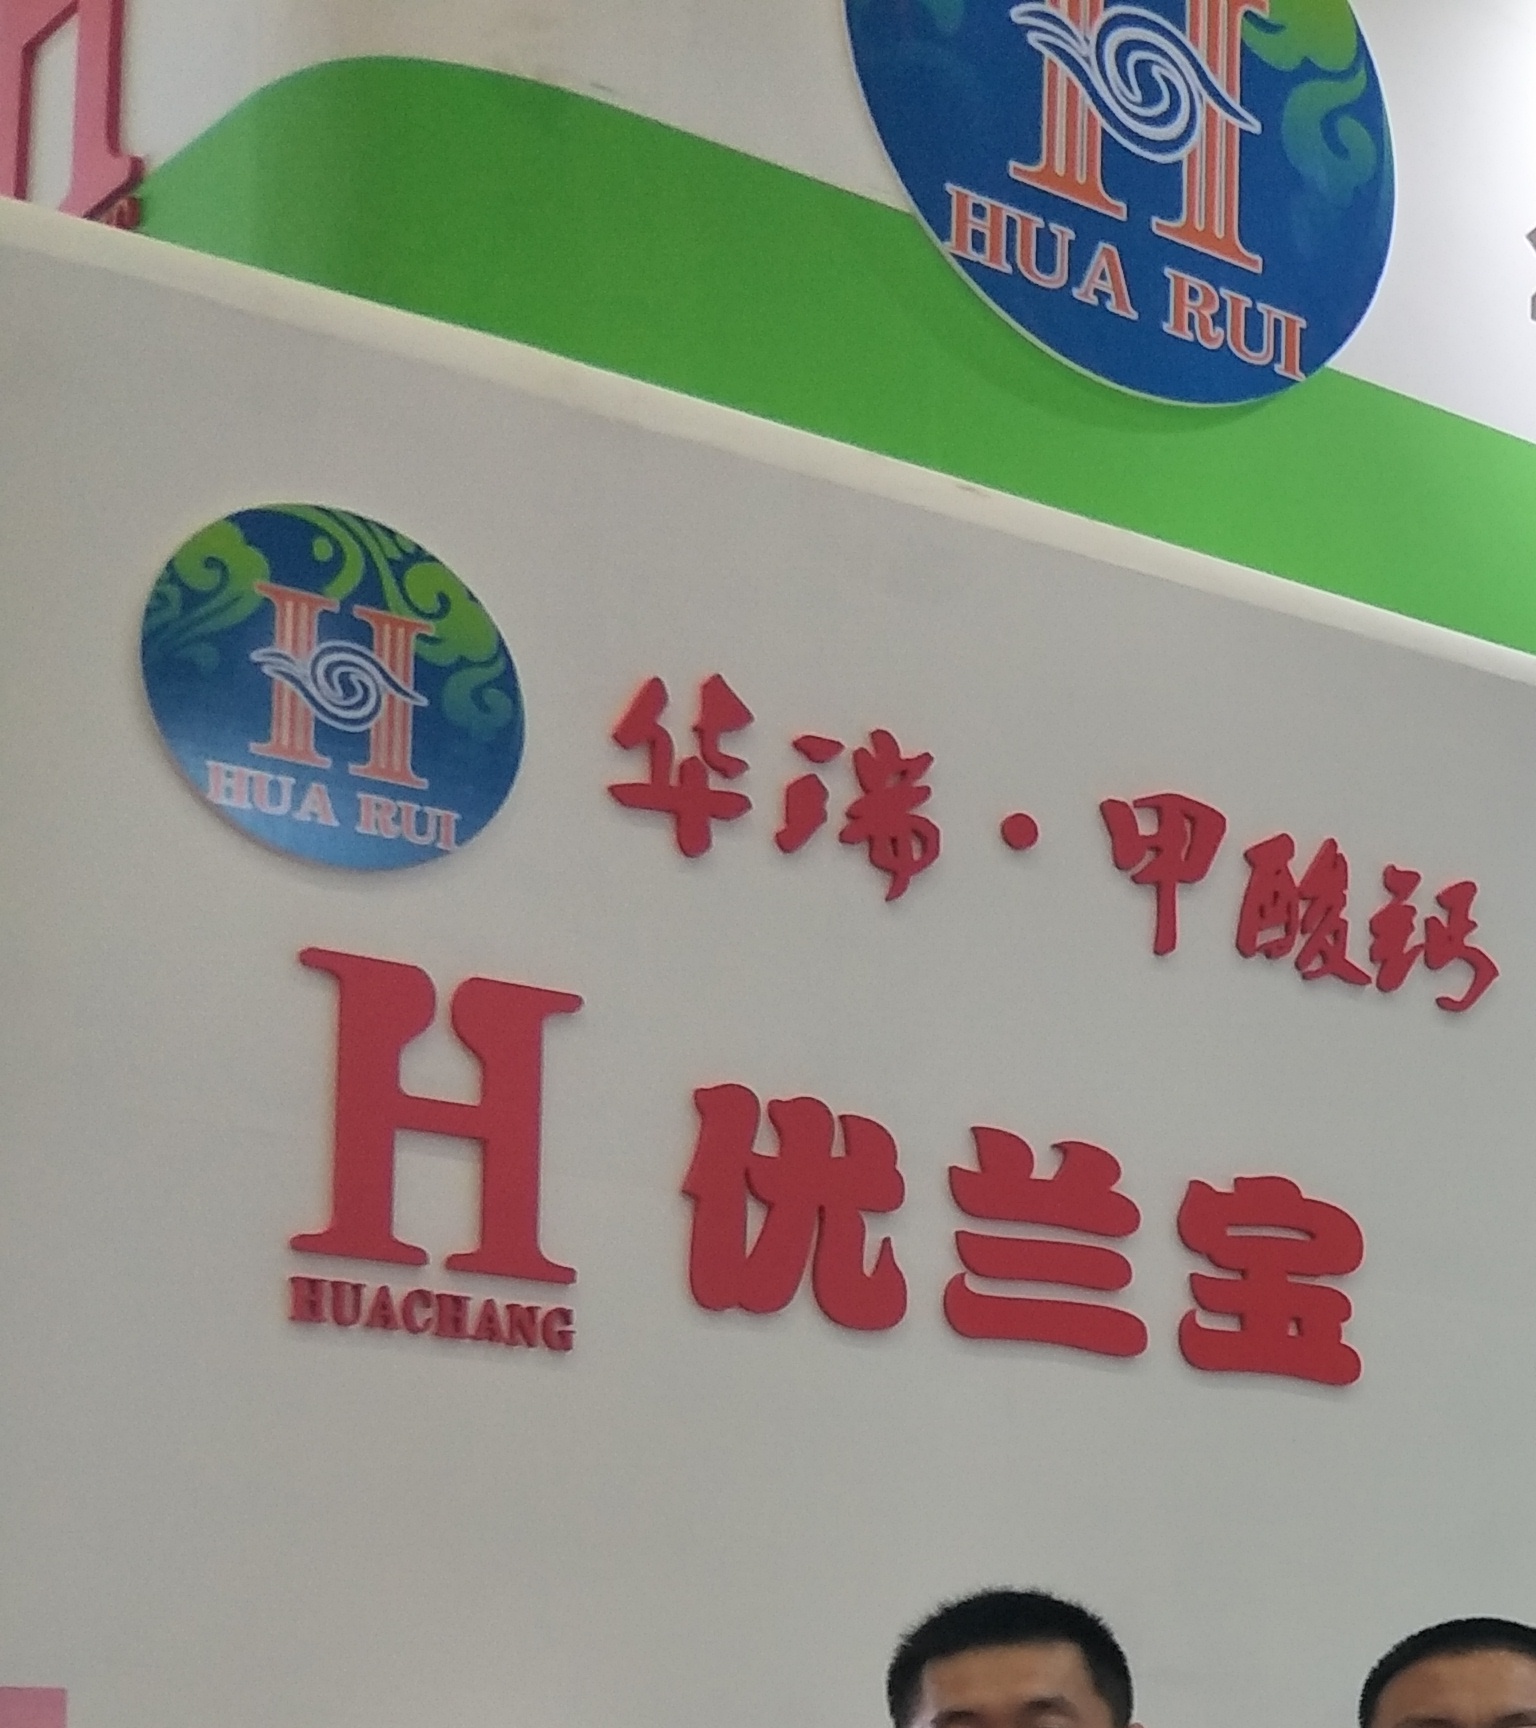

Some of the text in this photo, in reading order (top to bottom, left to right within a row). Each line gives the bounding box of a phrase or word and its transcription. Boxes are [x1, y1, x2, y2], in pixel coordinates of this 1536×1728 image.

[945, 182, 1307, 381] HUA RUI
[206, 760, 462, 851] HUA RUI
[290, 946, 583, 1285] H
[289, 1276, 575, 1352] HUACHANG
[682, 1083, 1365, 1386] 优兰宝
